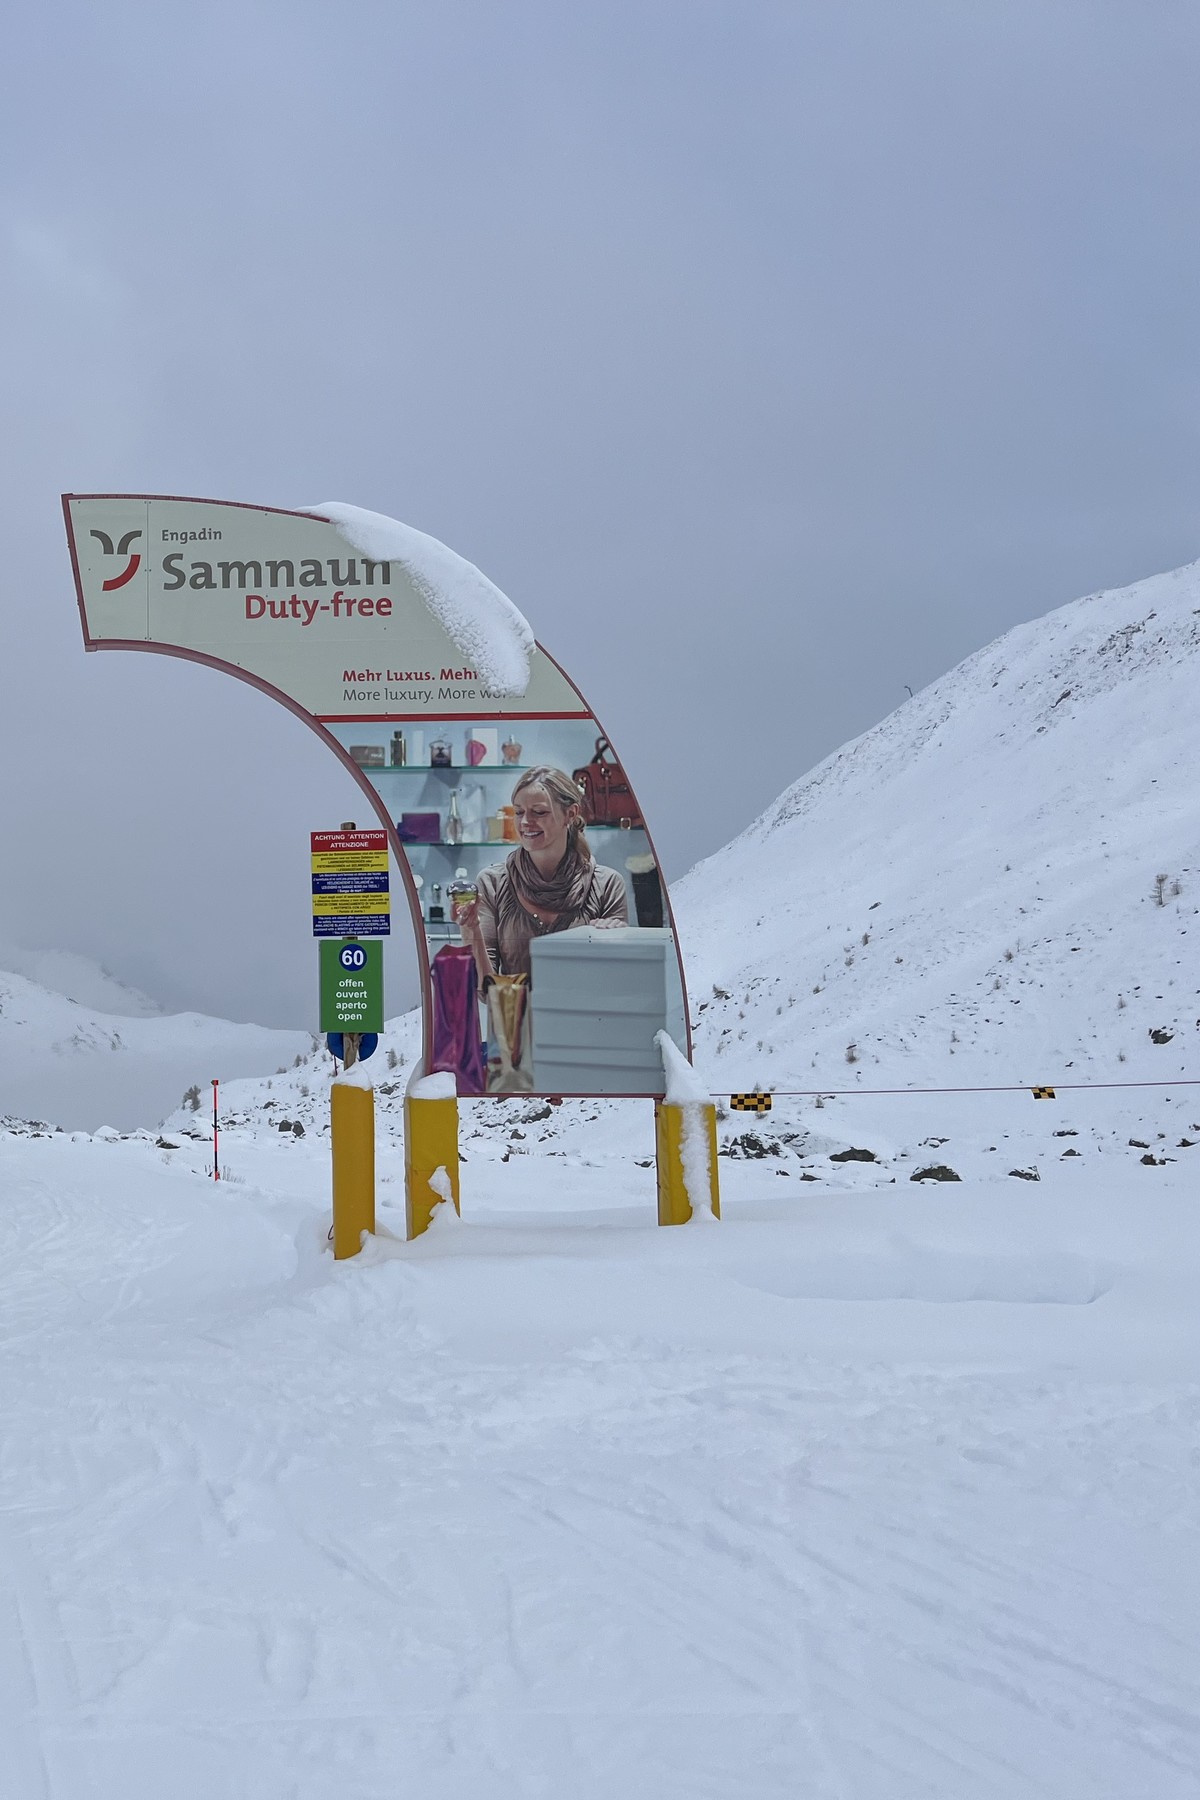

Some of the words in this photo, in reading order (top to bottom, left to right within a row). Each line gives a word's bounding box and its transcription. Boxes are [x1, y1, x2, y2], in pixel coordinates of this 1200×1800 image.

[161, 528, 222, 544] Engadin
[162, 553, 391, 590] Samnaun
[245, 591, 393, 626] Duty-free
[342, 669, 382, 682] Mehr
[386, 669, 436, 681] Luxus.
[343, 689, 380, 701] More
[384, 687, 434, 704] luxury.
[438, 687, 476, 700] More
[341, 950, 364, 966] 60
[339, 979, 364, 988] offen
[335, 1002, 368, 1010] aperto
[337, 1013, 363, 1022] open
